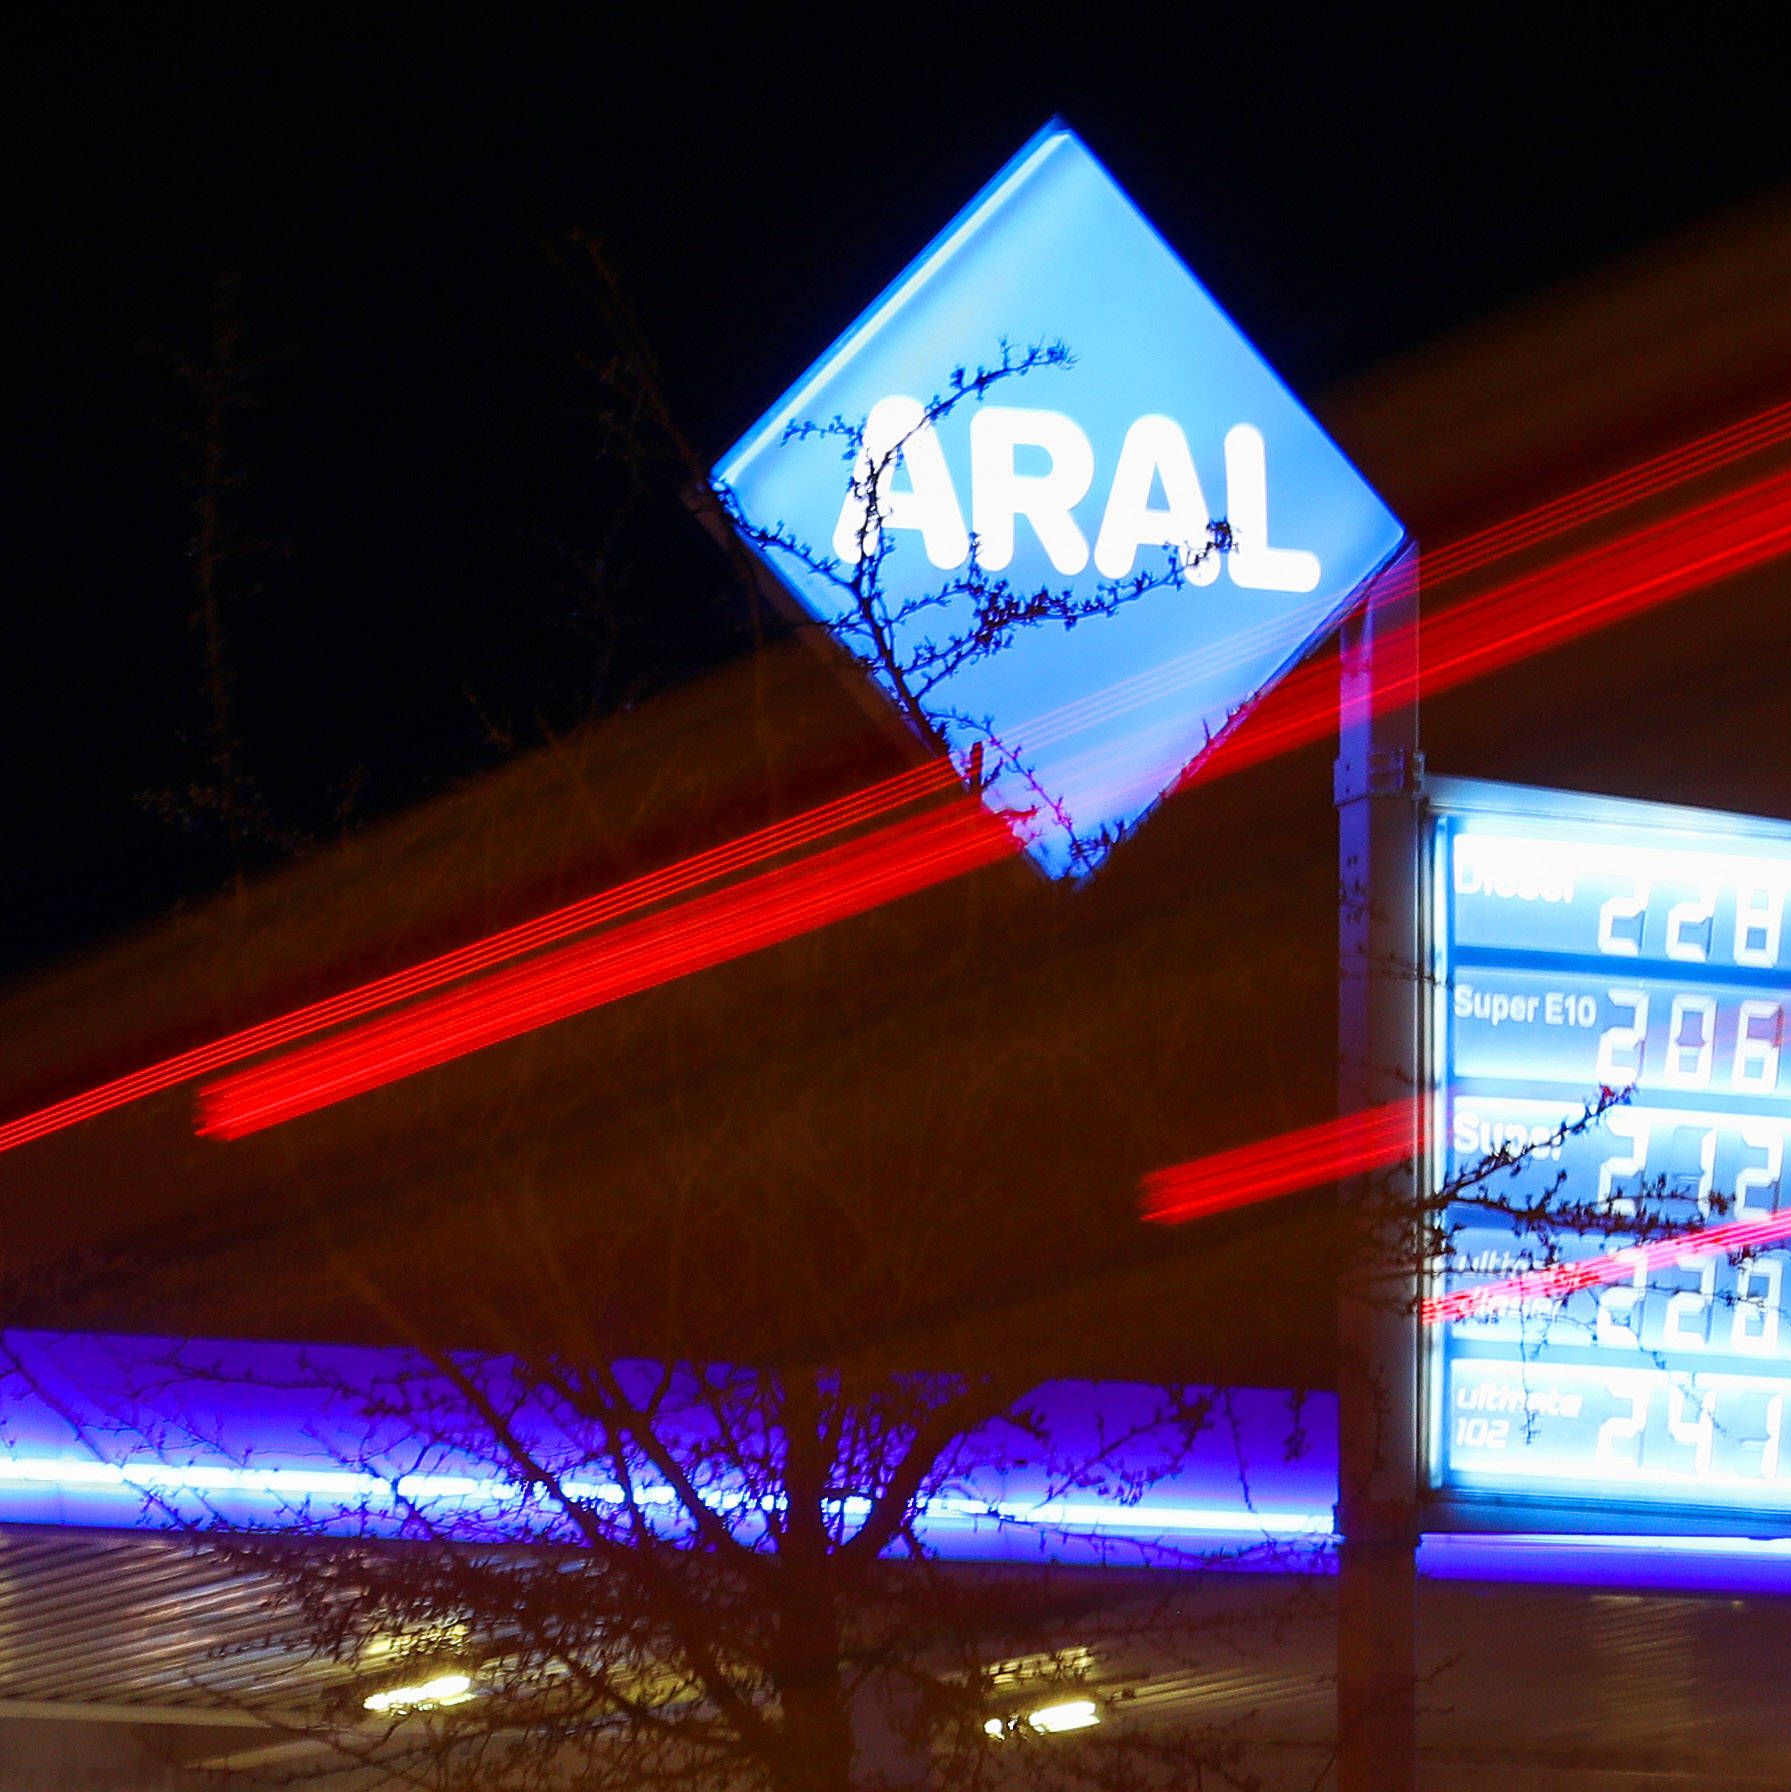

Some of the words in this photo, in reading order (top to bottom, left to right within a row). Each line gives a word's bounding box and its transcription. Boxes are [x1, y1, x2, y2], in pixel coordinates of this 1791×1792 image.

[832, 394, 1321, 594] ARAL
[1453, 984, 1538, 1027] Super
[1546, 991, 1597, 1028] E10
[1457, 1382, 1583, 1418] ultimate
[1456, 1417, 1510, 1449] 102
